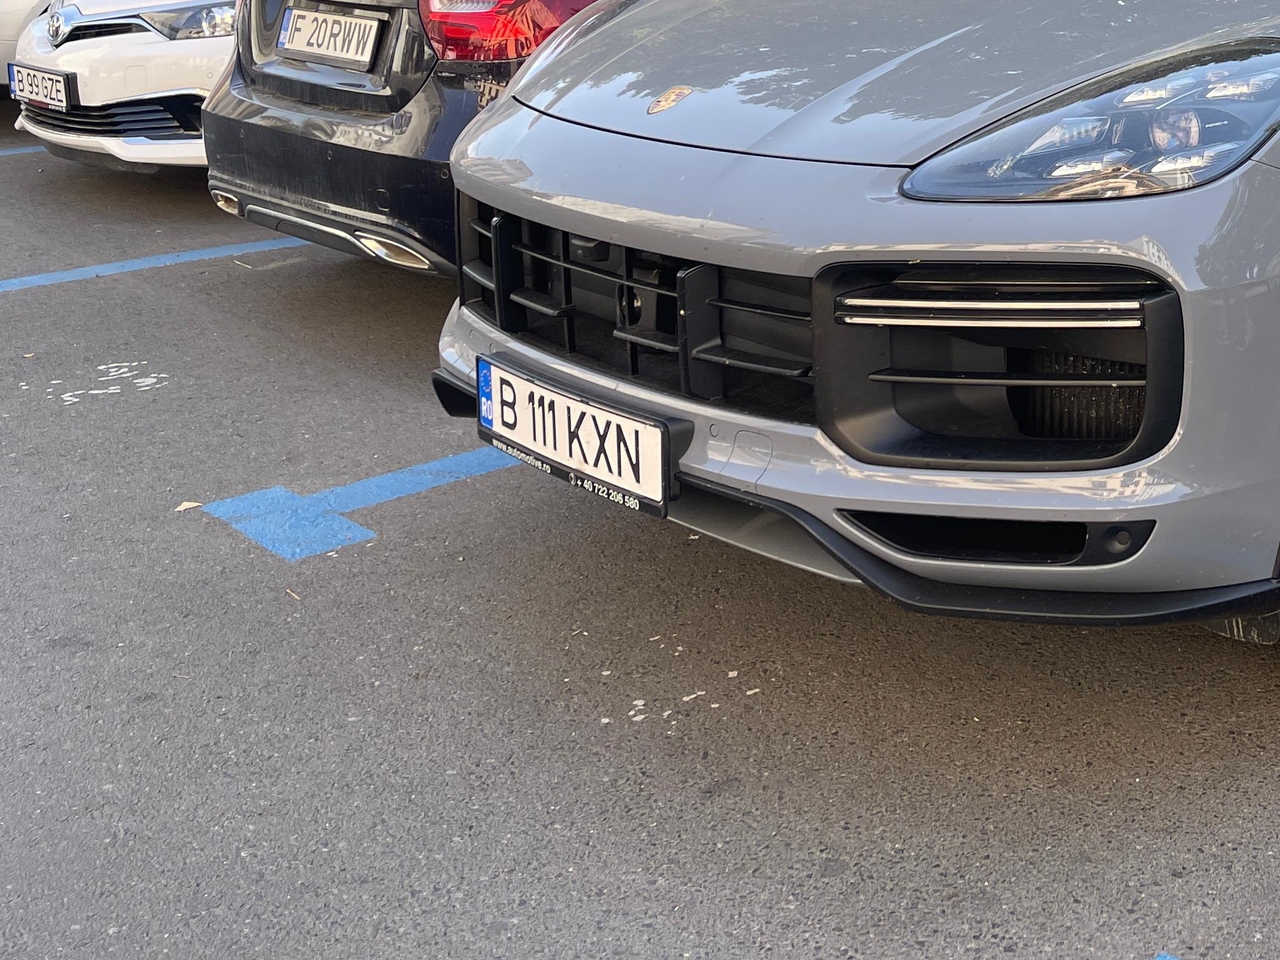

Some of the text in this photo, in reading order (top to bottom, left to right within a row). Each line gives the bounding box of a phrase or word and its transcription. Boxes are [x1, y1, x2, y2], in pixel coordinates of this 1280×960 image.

[287, 14, 307, 44] IF
[306, 16, 328, 48] 20
[326, 19, 373, 57] RWW
[16, 69, 25, 93] B
[26, 72, 40, 96] 99
[41, 75, 64, 103] GZE
[481, 397, 493, 420] RO
[499, 375, 641, 484] B 111 KXN
[491, 437, 552, 474] www.automotive.ro
[582, 478, 594, 495] 40
[593, 483, 609, 498] 722
[608, 488, 624, 505] 206
